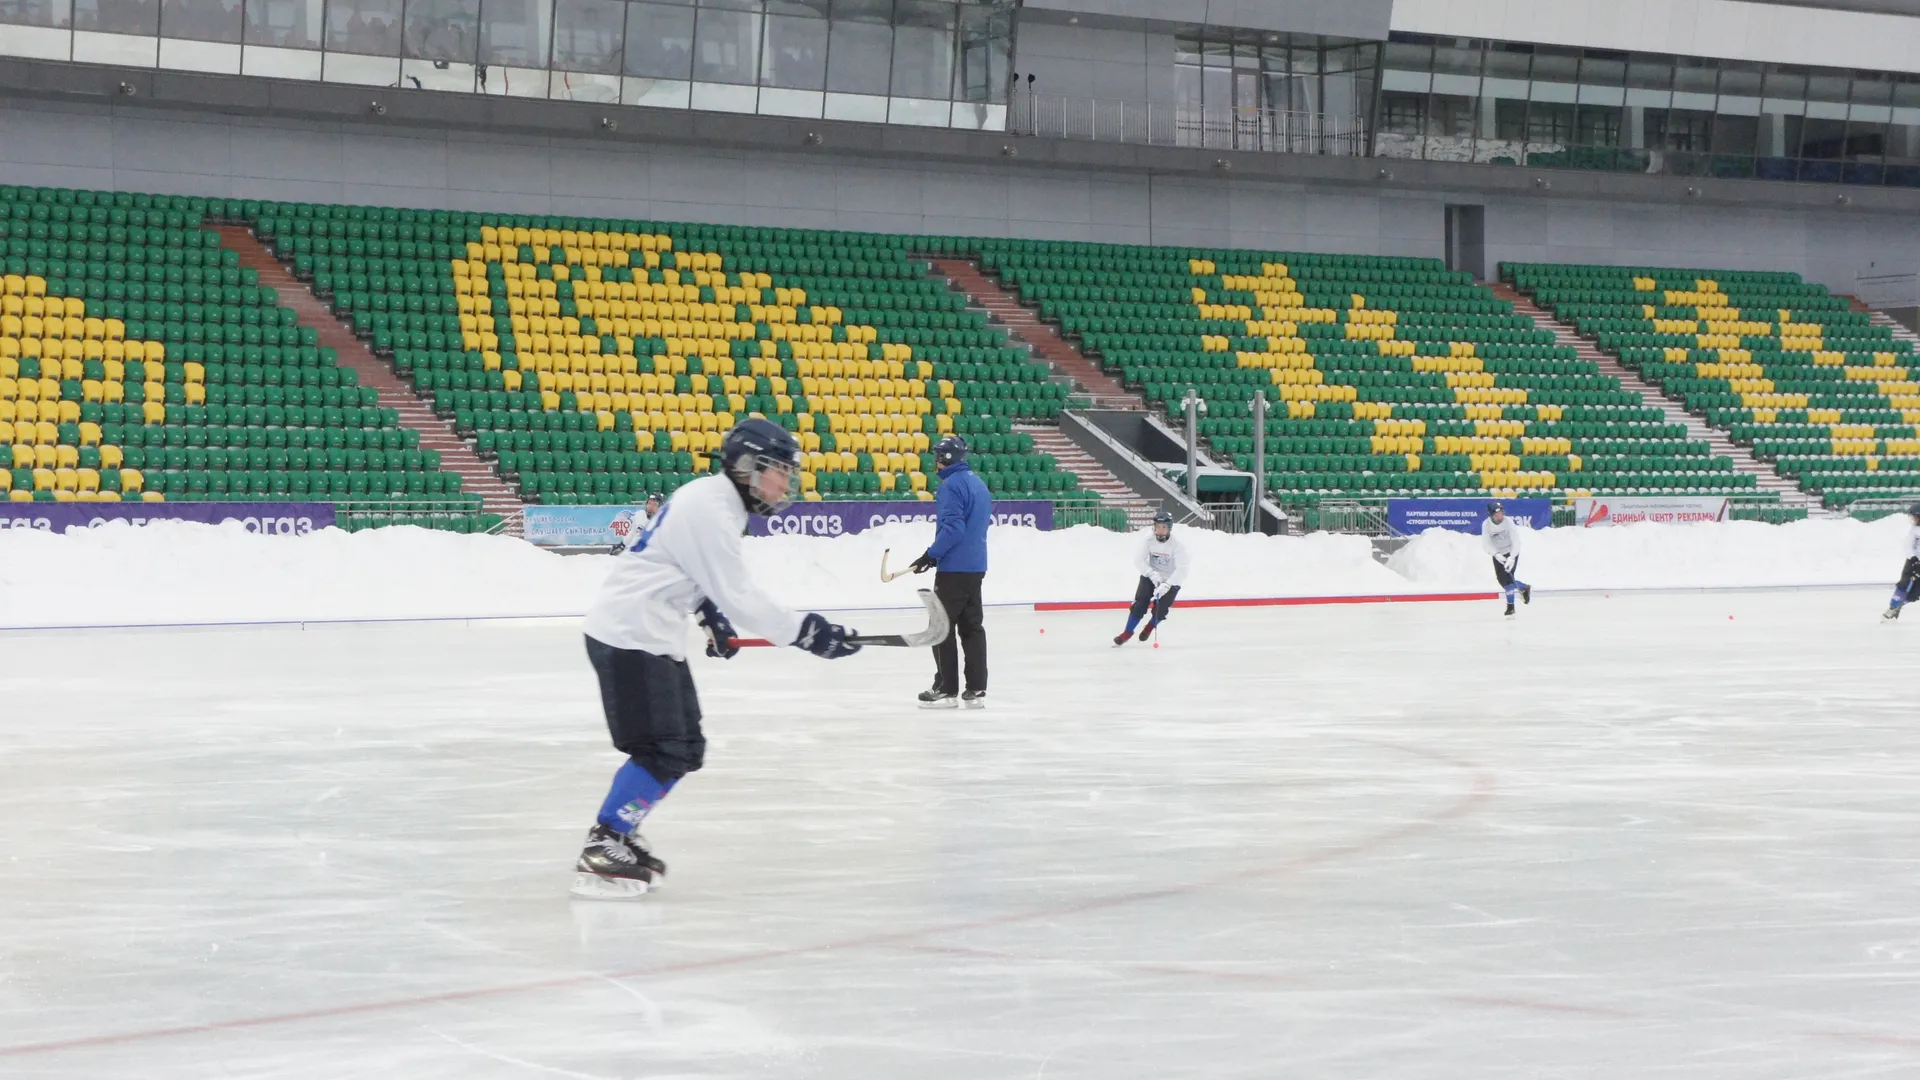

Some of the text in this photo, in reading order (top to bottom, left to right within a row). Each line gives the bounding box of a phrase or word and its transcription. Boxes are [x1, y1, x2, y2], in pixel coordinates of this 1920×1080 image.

[990, 513, 1036, 528] газ
[1612, 511, 1716, 523] ЕДИНЫЙ ЦЕНТР РЕКЛАМЫ
[243, 516, 313, 536] огаз
[610, 521, 630, 529] АВТО
[767, 515, 843, 535] согаз
